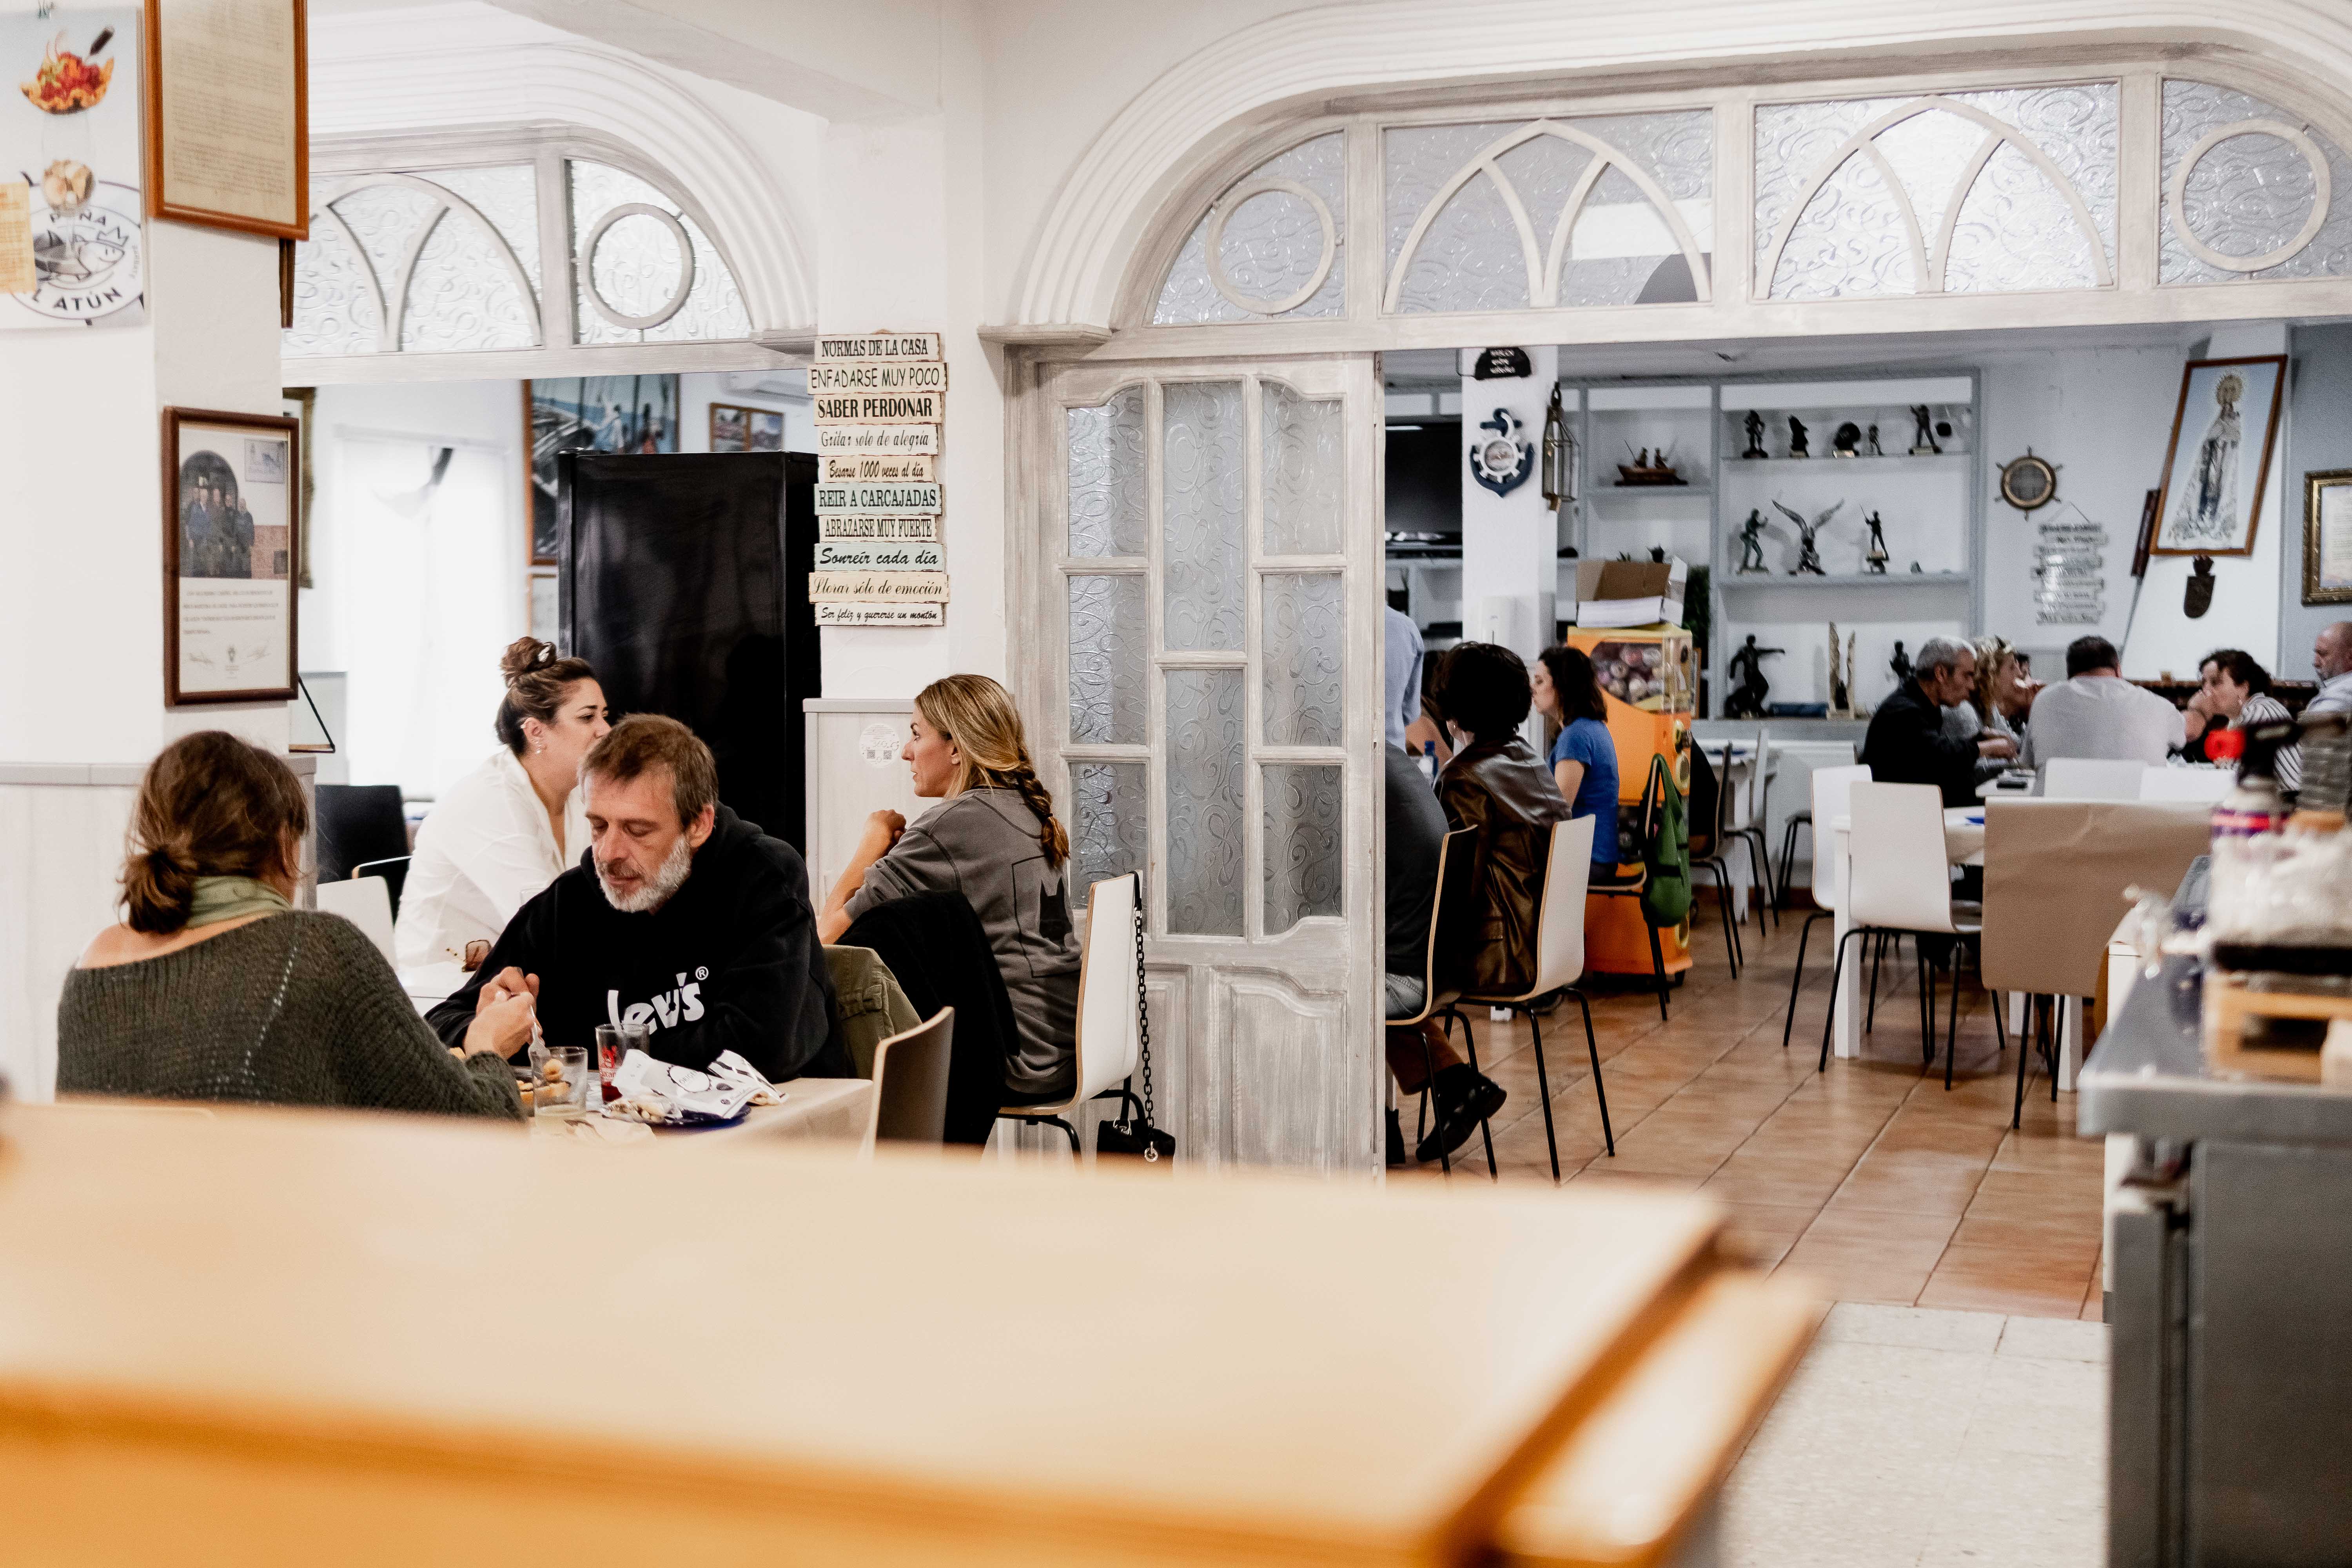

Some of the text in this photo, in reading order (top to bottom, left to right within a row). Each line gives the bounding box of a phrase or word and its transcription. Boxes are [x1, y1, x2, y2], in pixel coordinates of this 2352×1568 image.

[822, 339, 928, 357] NORMAS DE LA CASA
[811, 368, 939, 388] ENFADARSE MUY POCO
[818, 398, 932, 418] SABER PERDONAR
[822, 430, 929, 451] Gritar solo de alegría
[829, 459, 856, 478] Besarse
[860, 460, 880, 478] 1000
[882, 466, 898, 477] veces
[902, 461, 909, 477] al
[819, 489, 936, 507] REIR A CARCAJADAS
[825, 519, 932, 537] ABRAZARSE MUY FUERTE
[820, 547, 938, 564] Sonreír cada día
[812, 577, 942, 594] Llorar sólo de emoción
[821, 607, 835, 618] Ser
[837, 608, 853, 622] feliz
[857, 612, 861, 621] y
[864, 612, 895, 622] quererse
[910, 610, 937, 619] montón
